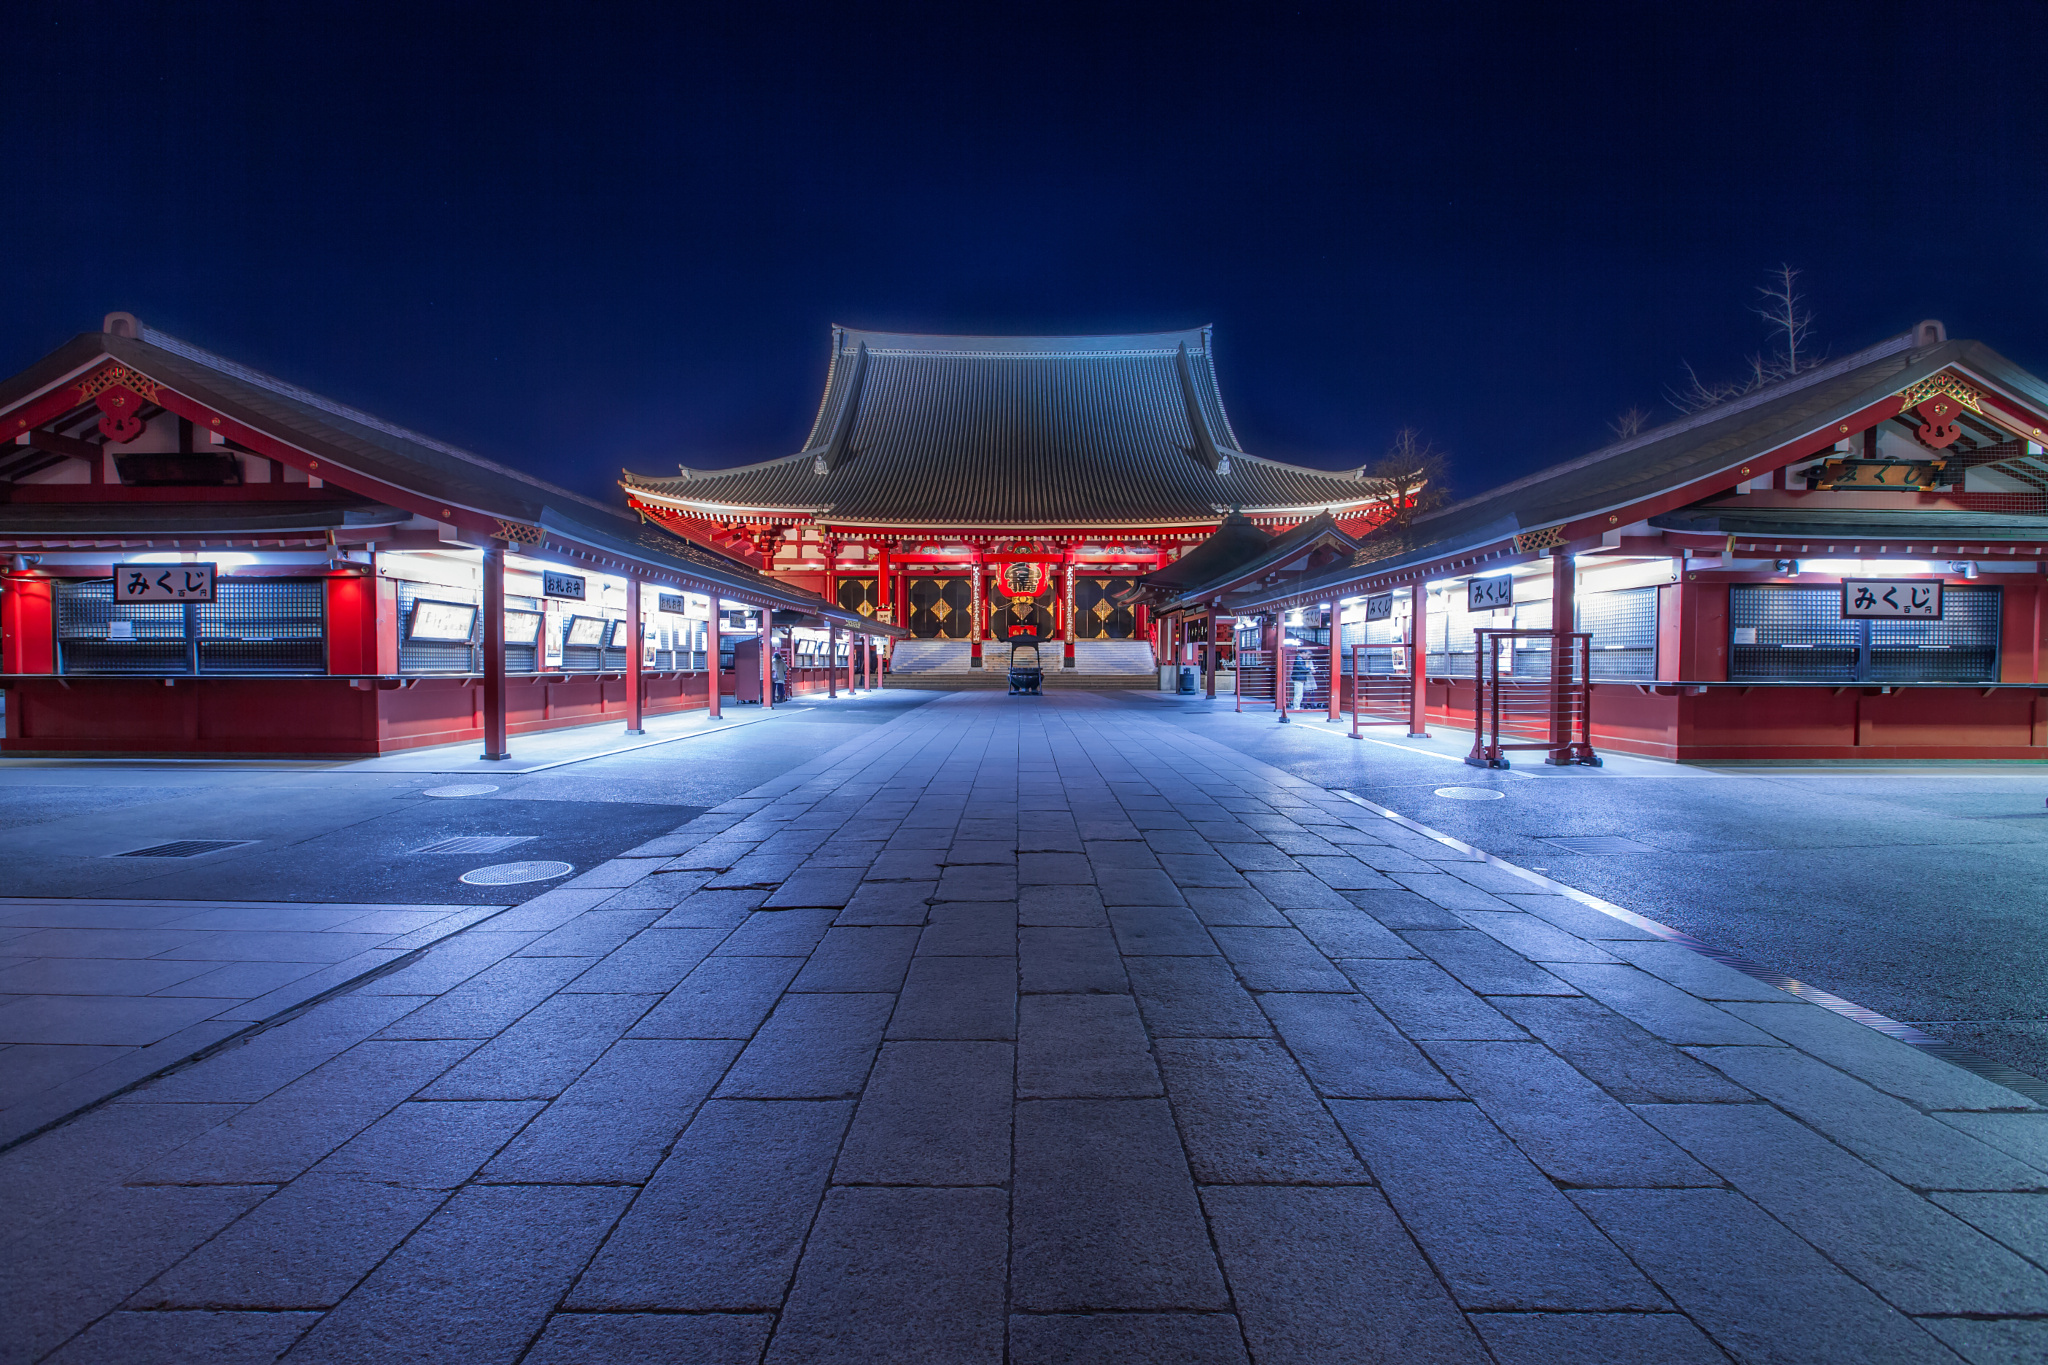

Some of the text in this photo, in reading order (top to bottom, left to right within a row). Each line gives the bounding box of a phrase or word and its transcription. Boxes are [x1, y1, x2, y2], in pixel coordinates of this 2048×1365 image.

[1836, 464, 1922, 484] みくじ
[127, 571, 204, 595] みくじ
[547, 576, 581, 596] お札お守
[1474, 581, 1508, 603] みくじ
[1854, 586, 1930, 610] みくじ
